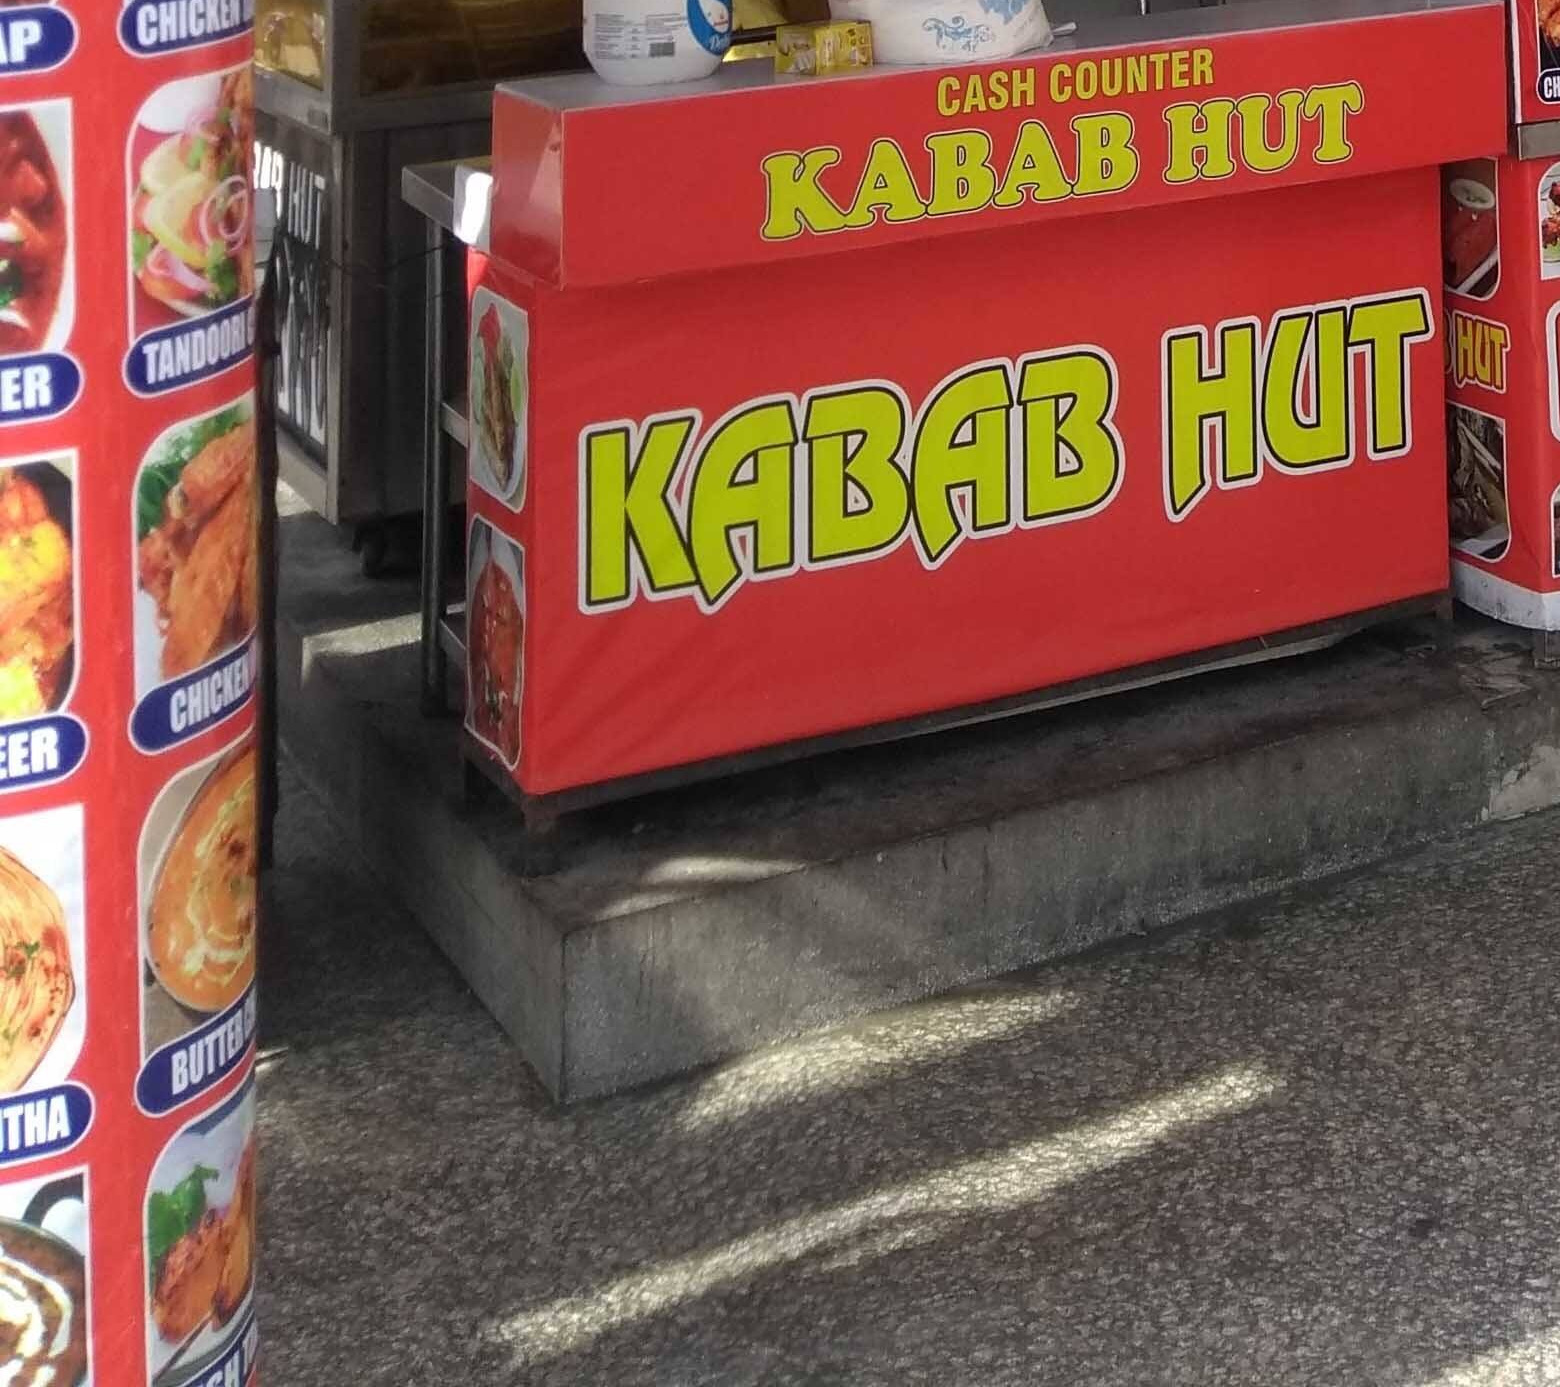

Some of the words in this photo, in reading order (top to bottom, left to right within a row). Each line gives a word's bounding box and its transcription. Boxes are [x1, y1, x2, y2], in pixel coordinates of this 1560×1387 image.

[937, 67, 1036, 117] CASH
[1050, 47, 1215, 101] COUNTER
[760, 111, 1140, 240] KABAB
[1162, 81, 1364, 184] HUT
[142, 310, 246, 385] TANDOORI
[1455, 312, 1508, 389] HUT
[583, 351, 1120, 606] KABAB
[1163, 293, 1430, 516] HUT
[171, 1008, 244, 1096] BUTTER
[0, 1094, 71, 1153] THA
